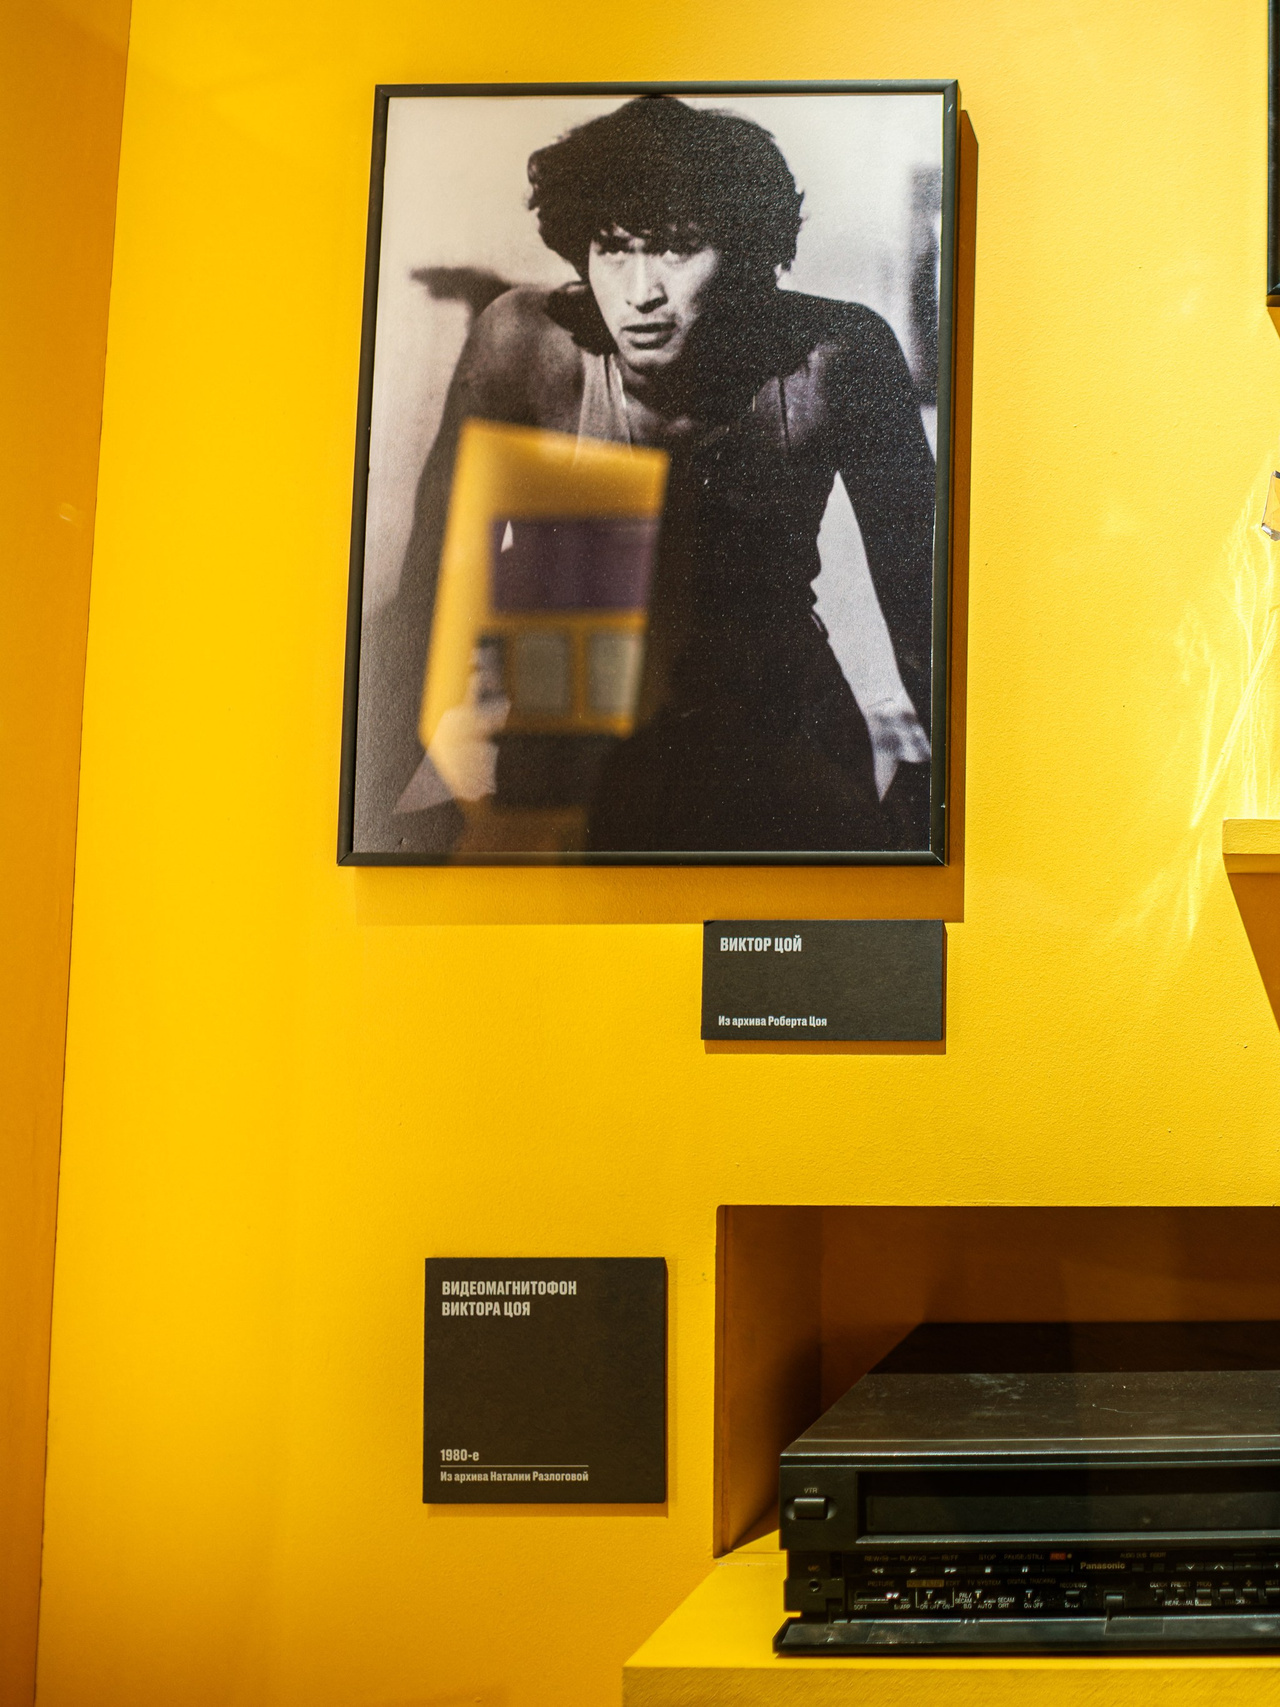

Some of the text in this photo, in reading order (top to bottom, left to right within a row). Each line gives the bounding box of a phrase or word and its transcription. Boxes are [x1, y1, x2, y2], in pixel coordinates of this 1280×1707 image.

[721, 935, 801, 953] ВИКТОР ЦОЙ
[719, 1016, 827, 1028] Из архива Роберта Цоя
[442, 1281, 577, 1297] ВИДЕОМАГНИТОФОН
[442, 1302, 530, 1317] ВИКТОРА ЦОЯ
[441, 1449, 479, 1461] 1980-е
[441, 1471, 588, 1483] Из архива Наталии Разлоговой
